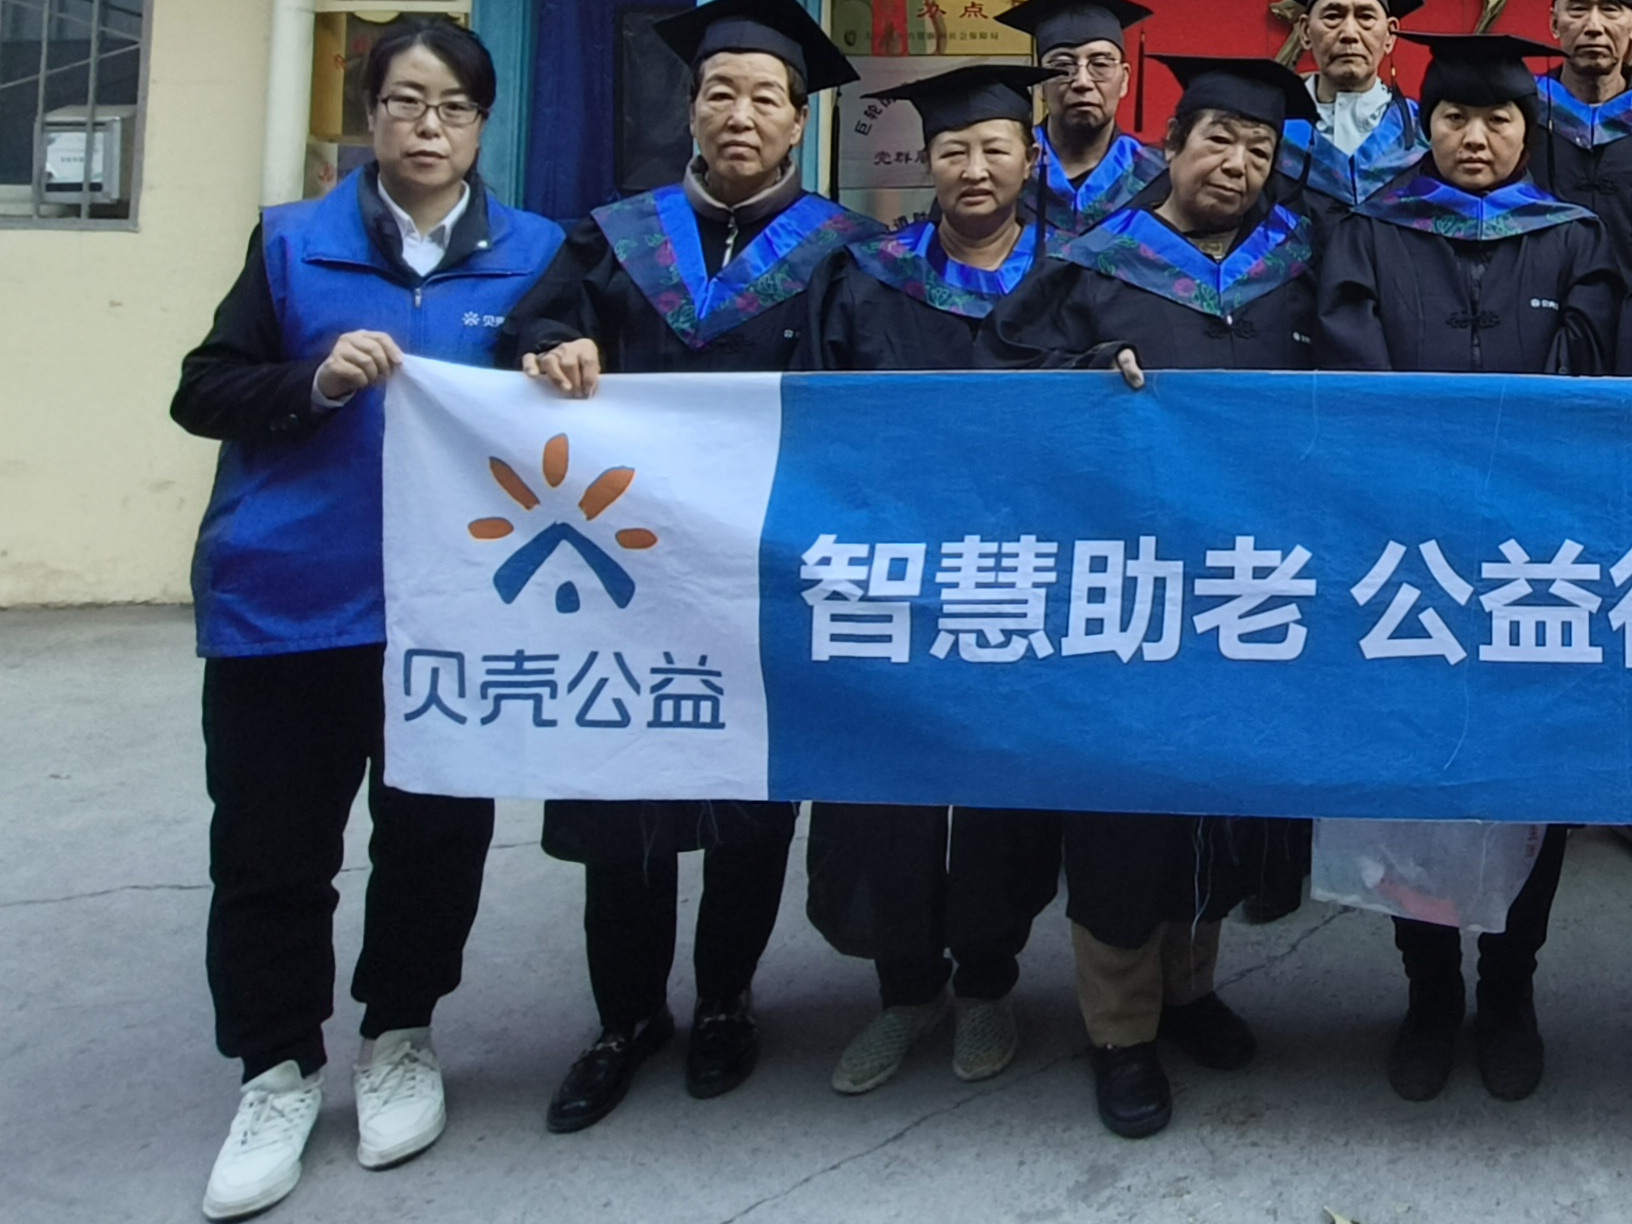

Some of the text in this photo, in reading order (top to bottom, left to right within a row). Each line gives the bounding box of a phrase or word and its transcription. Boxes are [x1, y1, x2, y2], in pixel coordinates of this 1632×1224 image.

[799, 533, 1317, 663] 智慧助老
[401, 648, 726, 729] 贝壳公益
